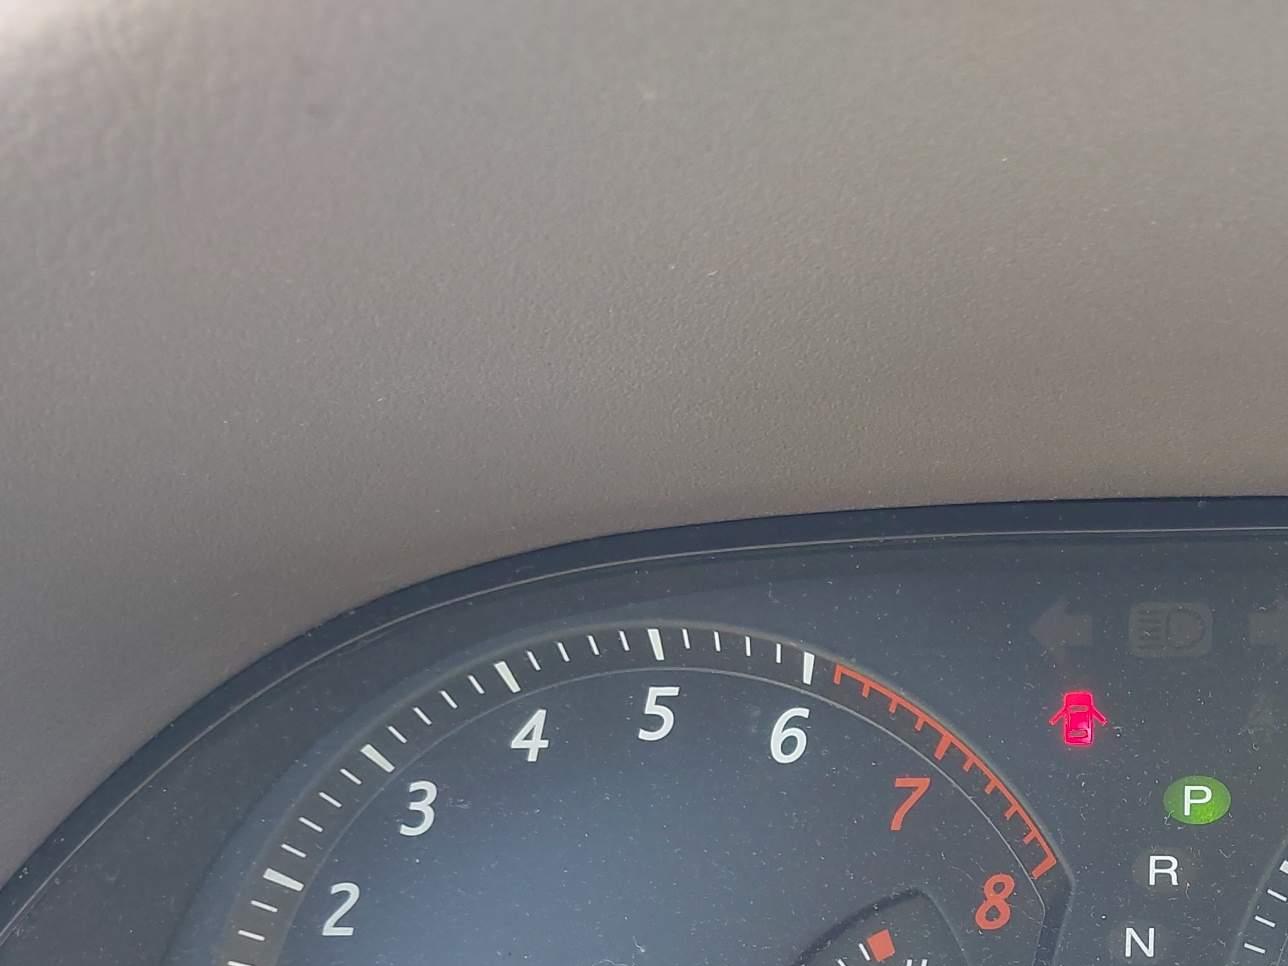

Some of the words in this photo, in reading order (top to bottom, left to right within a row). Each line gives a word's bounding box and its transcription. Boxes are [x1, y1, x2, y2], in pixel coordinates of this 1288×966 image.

[510, 709, 549, 762] 4
[638, 686, 679, 740] 5
[770, 708, 809, 763] 6
[399, 781, 437, 835] 3
[890, 778, 930, 831] 7
[1183, 786, 1211, 815] P
[1149, 857, 1179, 885] R
[322, 883, 360, 936] 2
[975, 873, 1015, 929] 8
[1125, 929, 1154, 956] N
